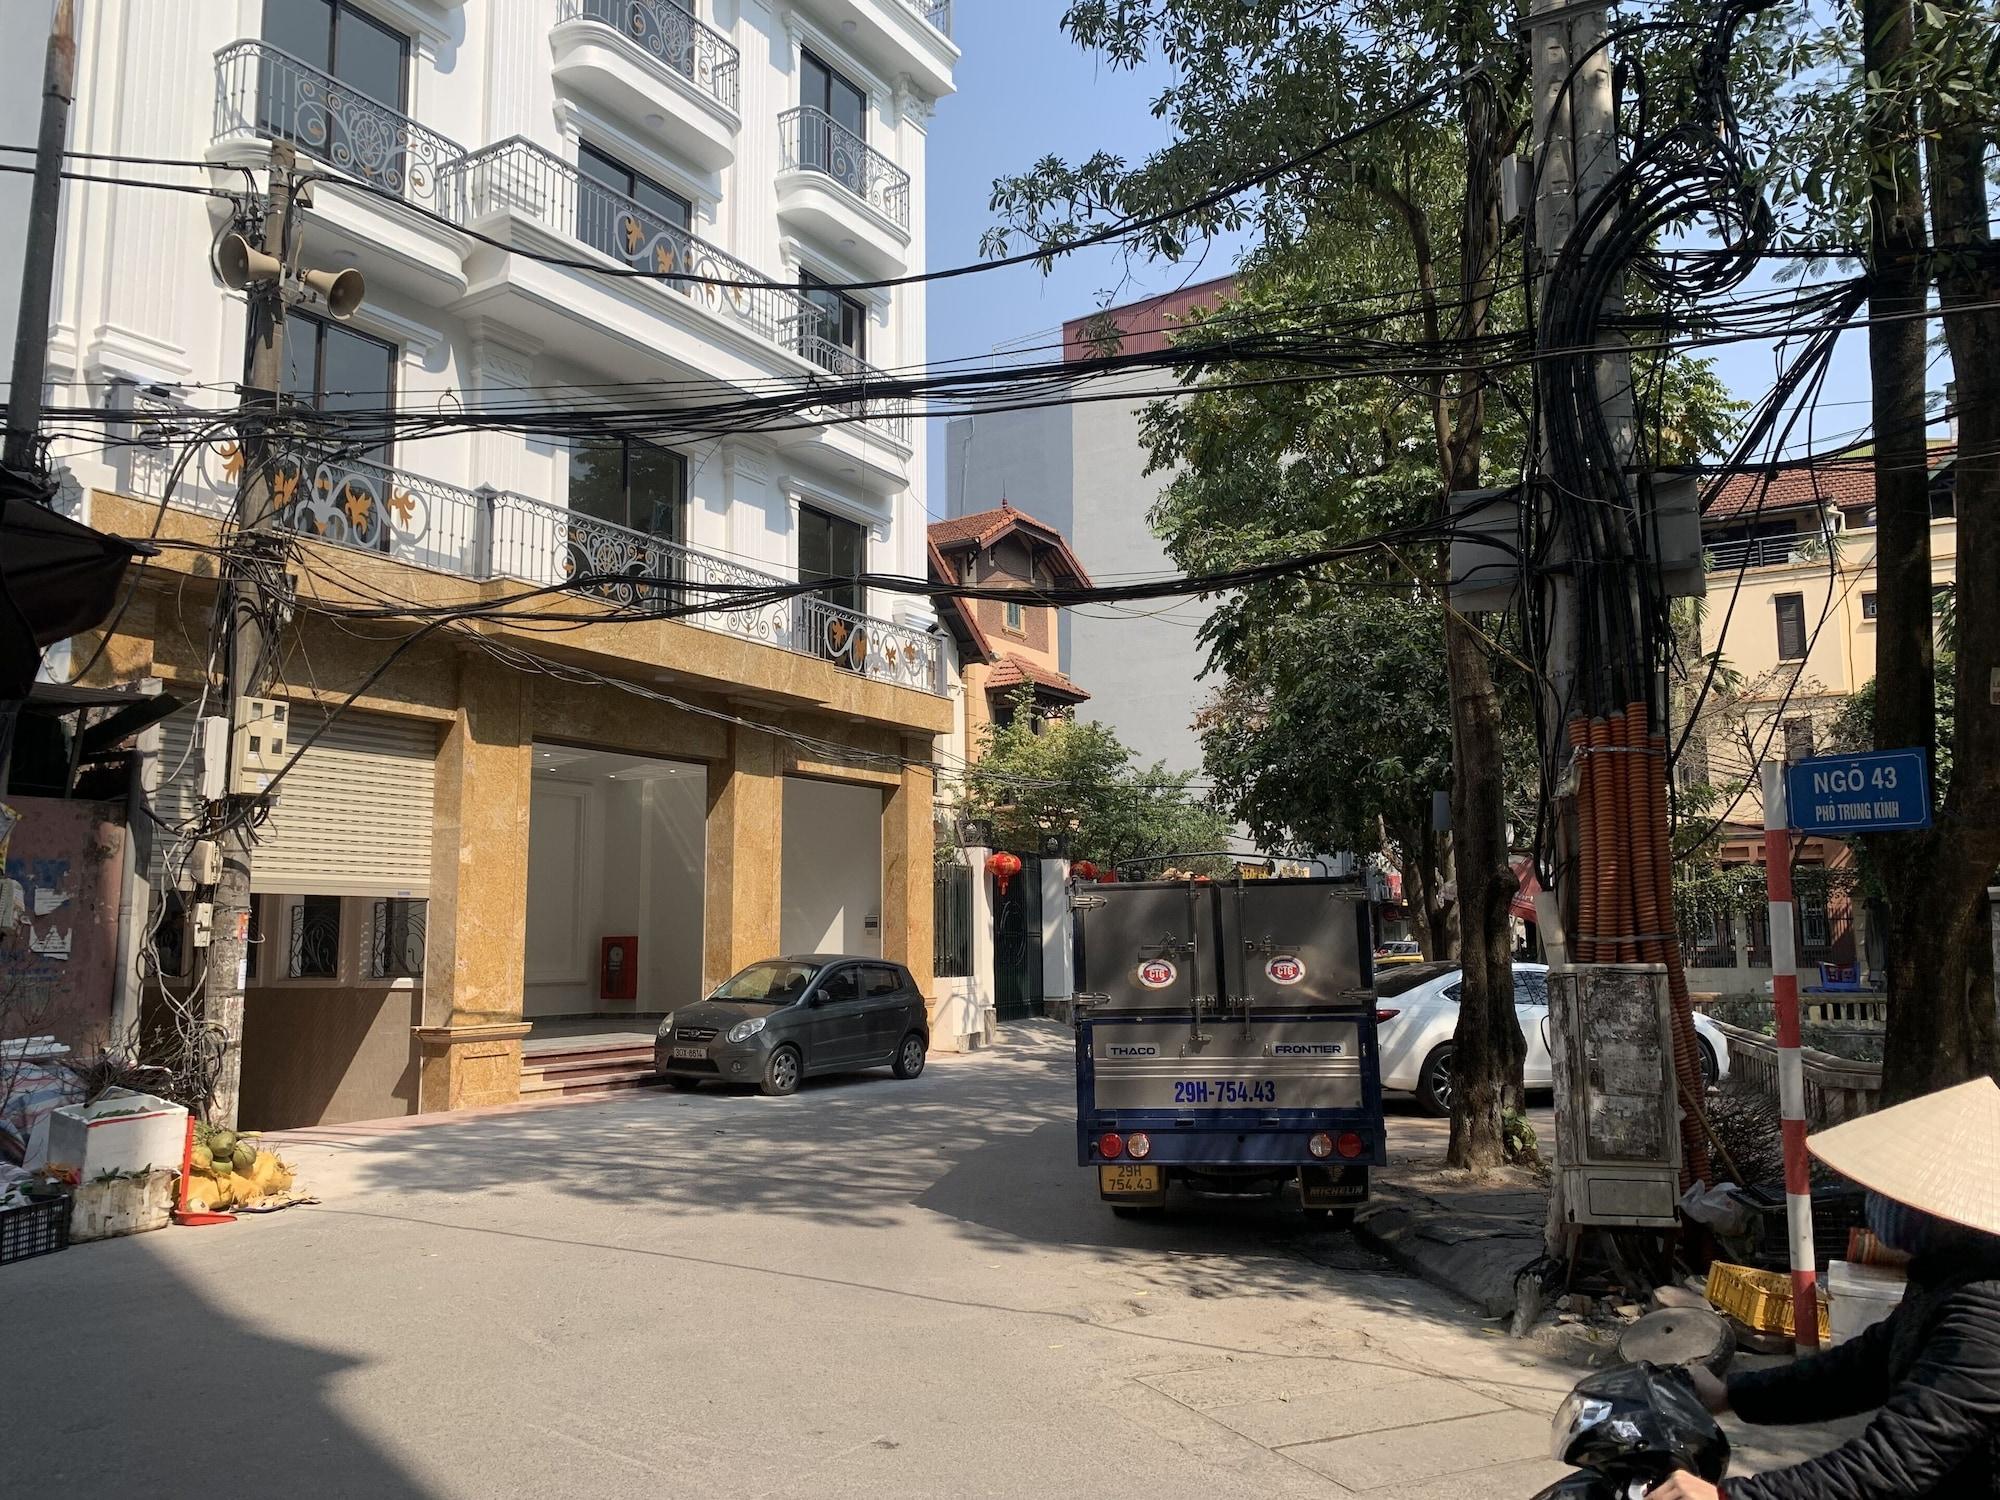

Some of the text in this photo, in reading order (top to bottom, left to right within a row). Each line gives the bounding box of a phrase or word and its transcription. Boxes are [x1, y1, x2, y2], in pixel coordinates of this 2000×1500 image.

[1813, 762, 1897, 794] NGÕ 43
[1815, 795, 1836, 822] PHỐ
[1838, 803, 1872, 821] TRUNG
[1110, 1047, 1156, 1056] THACO
[1275, 1045, 1342, 1054] FRONTIER
[1174, 1080, 1276, 1103] 29H-754.43
[1117, 1165, 1142, 1178] 29H
[1108, 1178, 1153, 1191] 754.43
